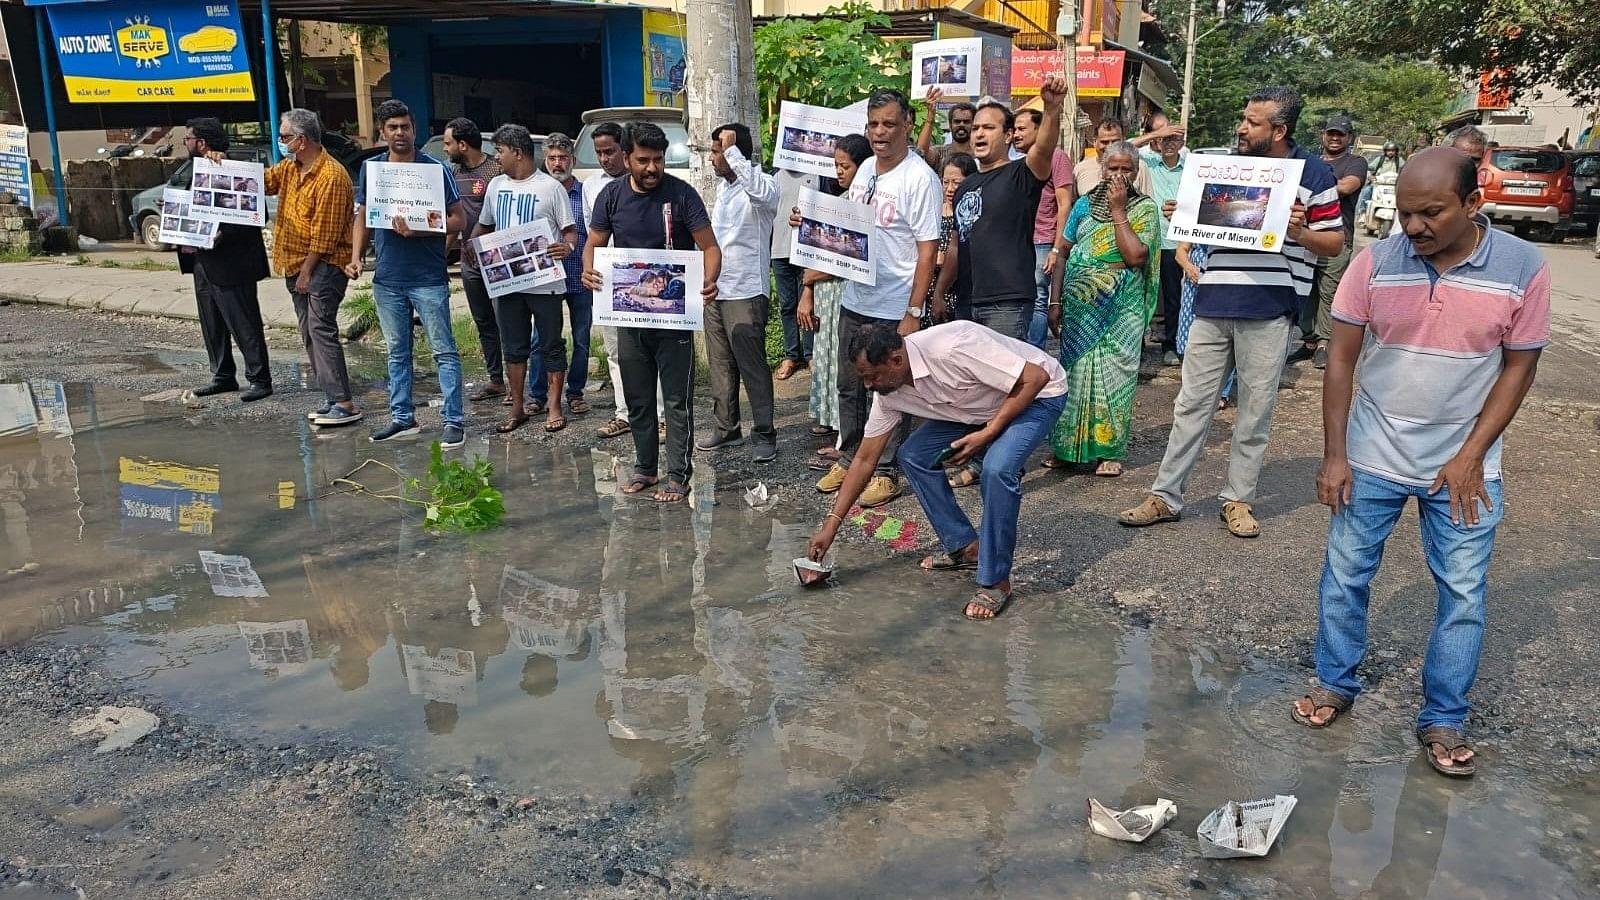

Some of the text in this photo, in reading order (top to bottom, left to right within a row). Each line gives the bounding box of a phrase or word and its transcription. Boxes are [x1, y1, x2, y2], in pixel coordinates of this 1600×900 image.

[131, 30, 151, 39] MAK
[60, 35, 112, 54] AUTO ZONE
[123, 41, 164, 53] SERVE
[1076, 69, 1100, 79] aints
[137, 88, 175, 96] CAR CARE
[389, 197, 414, 207] Drinking
[415, 199, 433, 207] Water
[397, 206, 410, 214] NOT
[1172, 226, 1258, 245] The River of Misery
